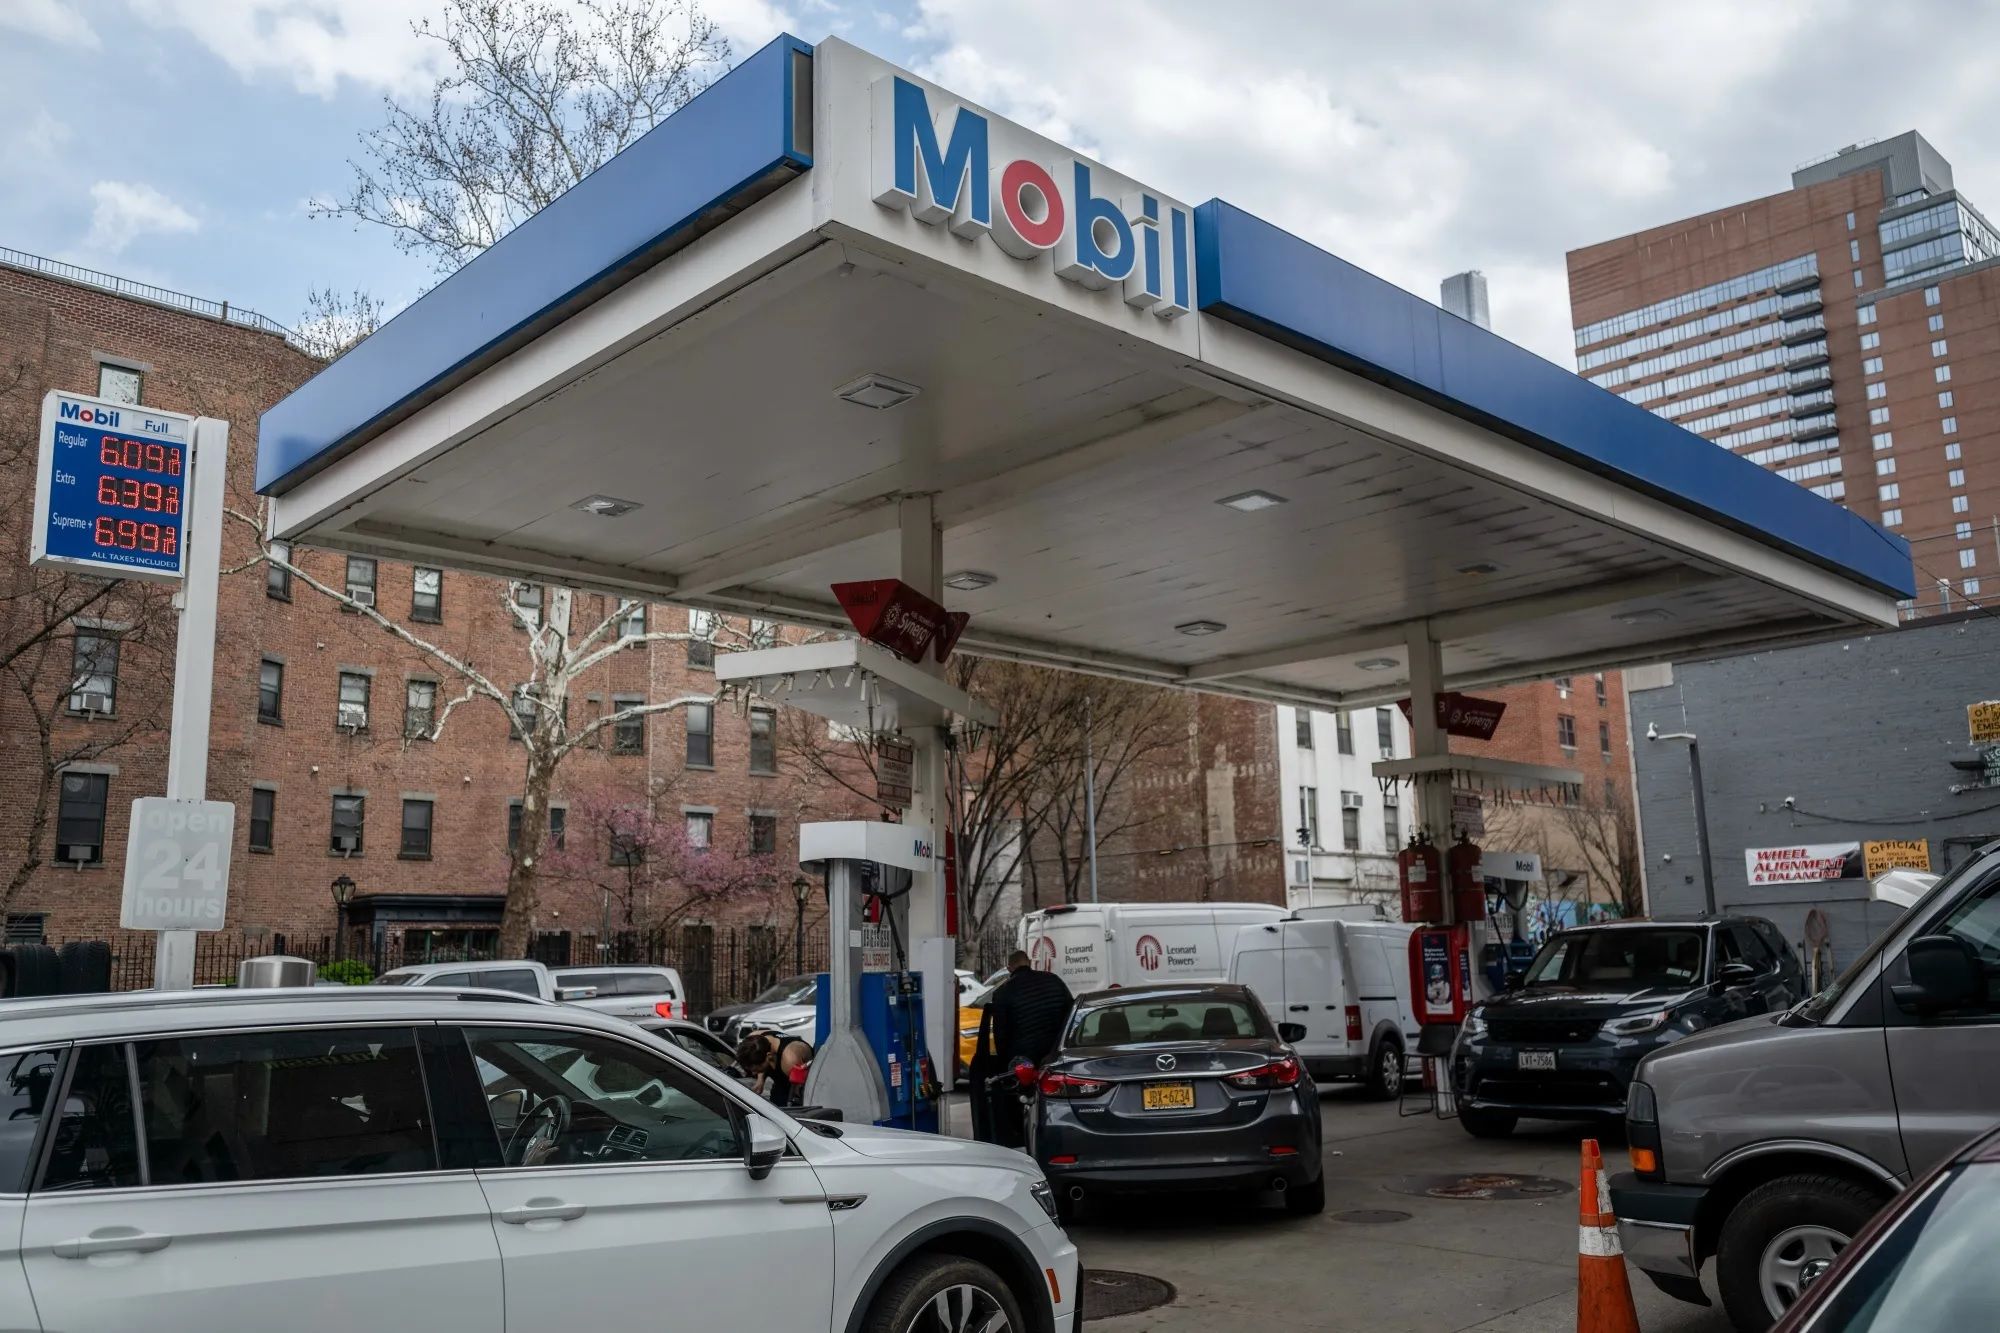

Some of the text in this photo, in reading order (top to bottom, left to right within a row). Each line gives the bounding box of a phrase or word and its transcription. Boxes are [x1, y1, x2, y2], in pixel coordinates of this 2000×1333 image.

[892, 74, 1191, 310] Mobil
[60, 401, 169, 434] Mobil Full
[58, 430, 88, 448] Regular
[55, 470, 76, 485] Extra
[52, 512, 87, 530] Supreme
[91, 551, 177, 569] ALL TAXES INCLUDED
[897, 612, 932, 647] Synergy
[1462, 711, 1493, 730] Synergy
[145, 808, 226, 838] open
[1757, 848, 1810, 860] WHEEL
[1870, 841, 1922, 854] OFFICIAL
[140, 838, 222, 891] 24
[1515, 860, 1534, 872] Mobil
[1754, 856, 1846, 873] ALIGNMENT
[1755, 868, 1842, 882] & BALANCING
[134, 890, 222, 919] hours
[1065, 943, 1094, 954] Leonard
[1166, 944, 1197, 955] Leonard
[1065, 955, 1090, 964] Powers
[1167, 956, 1195, 965] Powers
